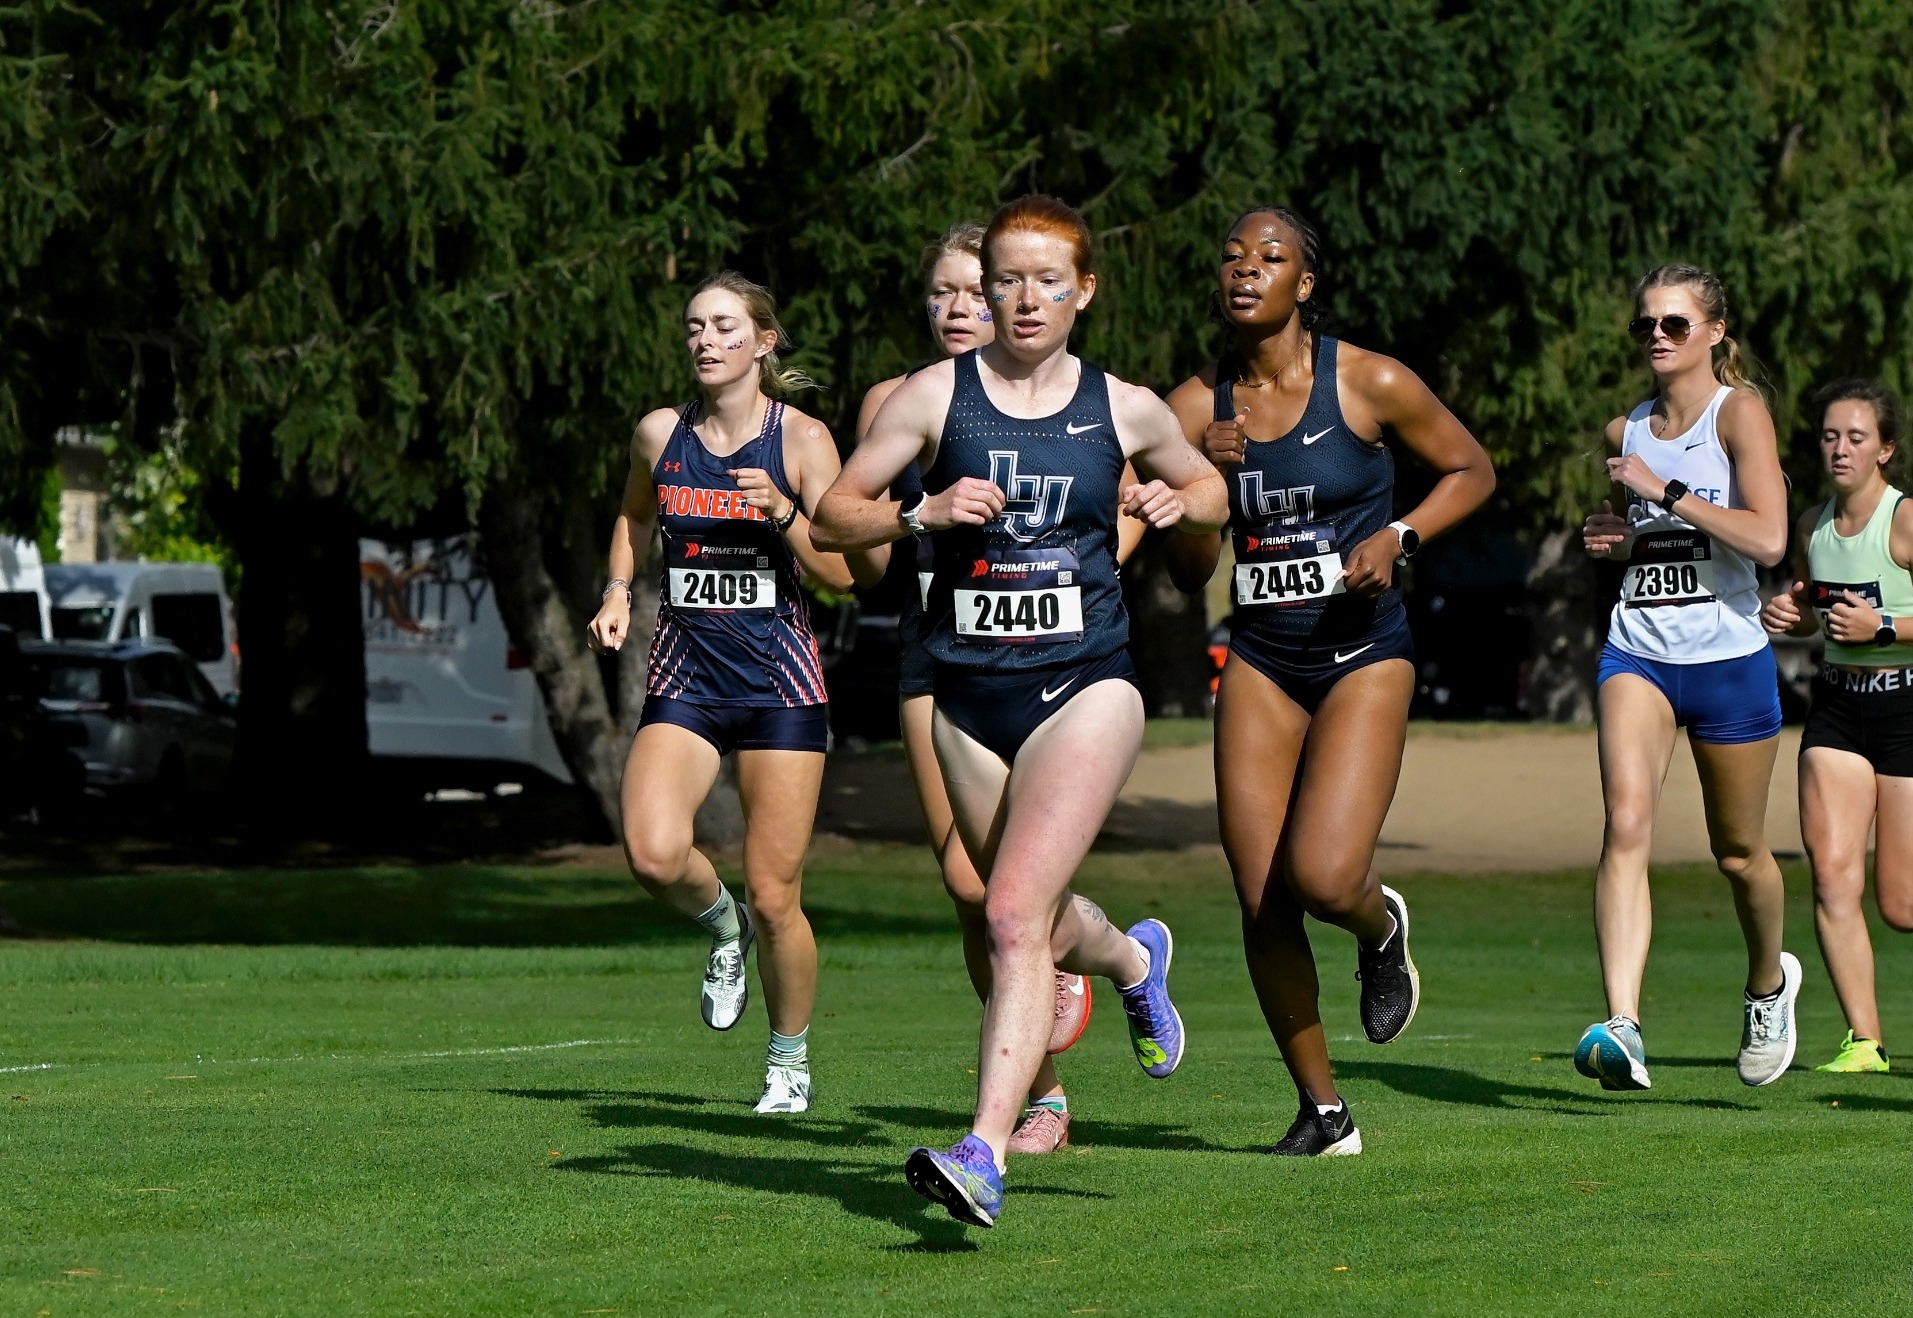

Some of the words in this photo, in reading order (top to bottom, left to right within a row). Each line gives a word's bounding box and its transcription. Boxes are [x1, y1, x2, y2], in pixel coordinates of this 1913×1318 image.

[701, 545, 758, 555] PRIMETIME
[1260, 531, 1317, 546] PRIMETIME
[1648, 538, 1694, 549] PRIMETIME
[991, 560, 1060, 572] PRIMETIME
[683, 572, 758, 605] 2409
[1250, 560, 1325, 600] 2443
[1634, 564, 1698, 598] 2390
[973, 592, 1060, 632] 2440
[1845, 669, 1901, 693] NIKE
